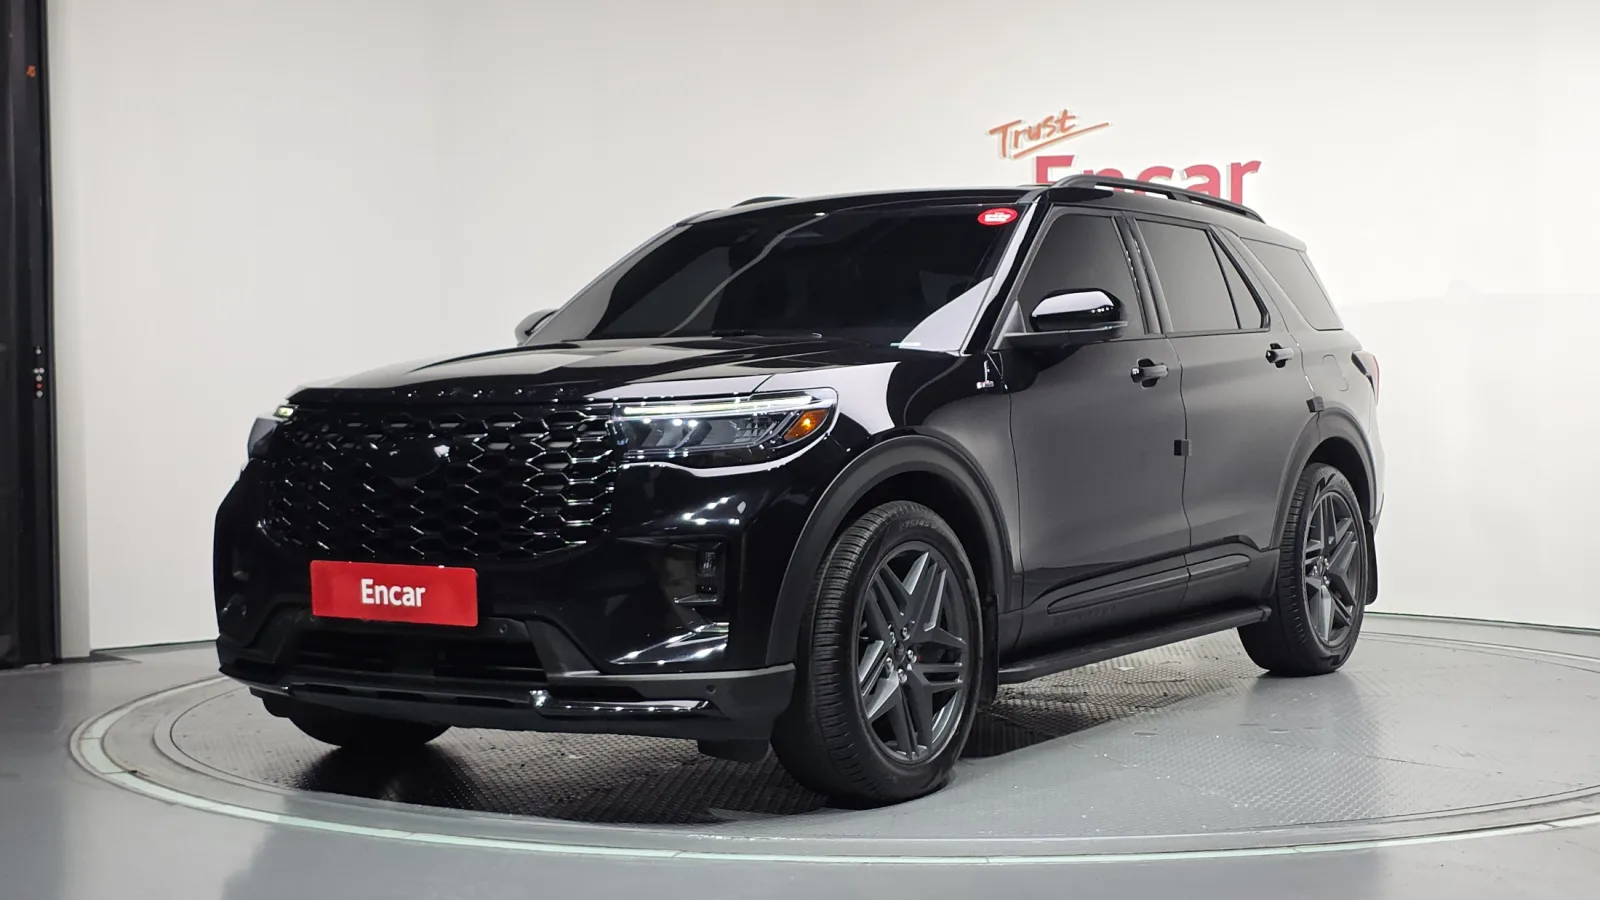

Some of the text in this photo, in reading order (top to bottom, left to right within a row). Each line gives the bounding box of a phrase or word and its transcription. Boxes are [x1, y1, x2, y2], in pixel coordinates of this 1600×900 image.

[989, 109, 1077, 158] Trust
[1036, 154, 1262, 206] Ear
[360, 578, 426, 607] Encar
